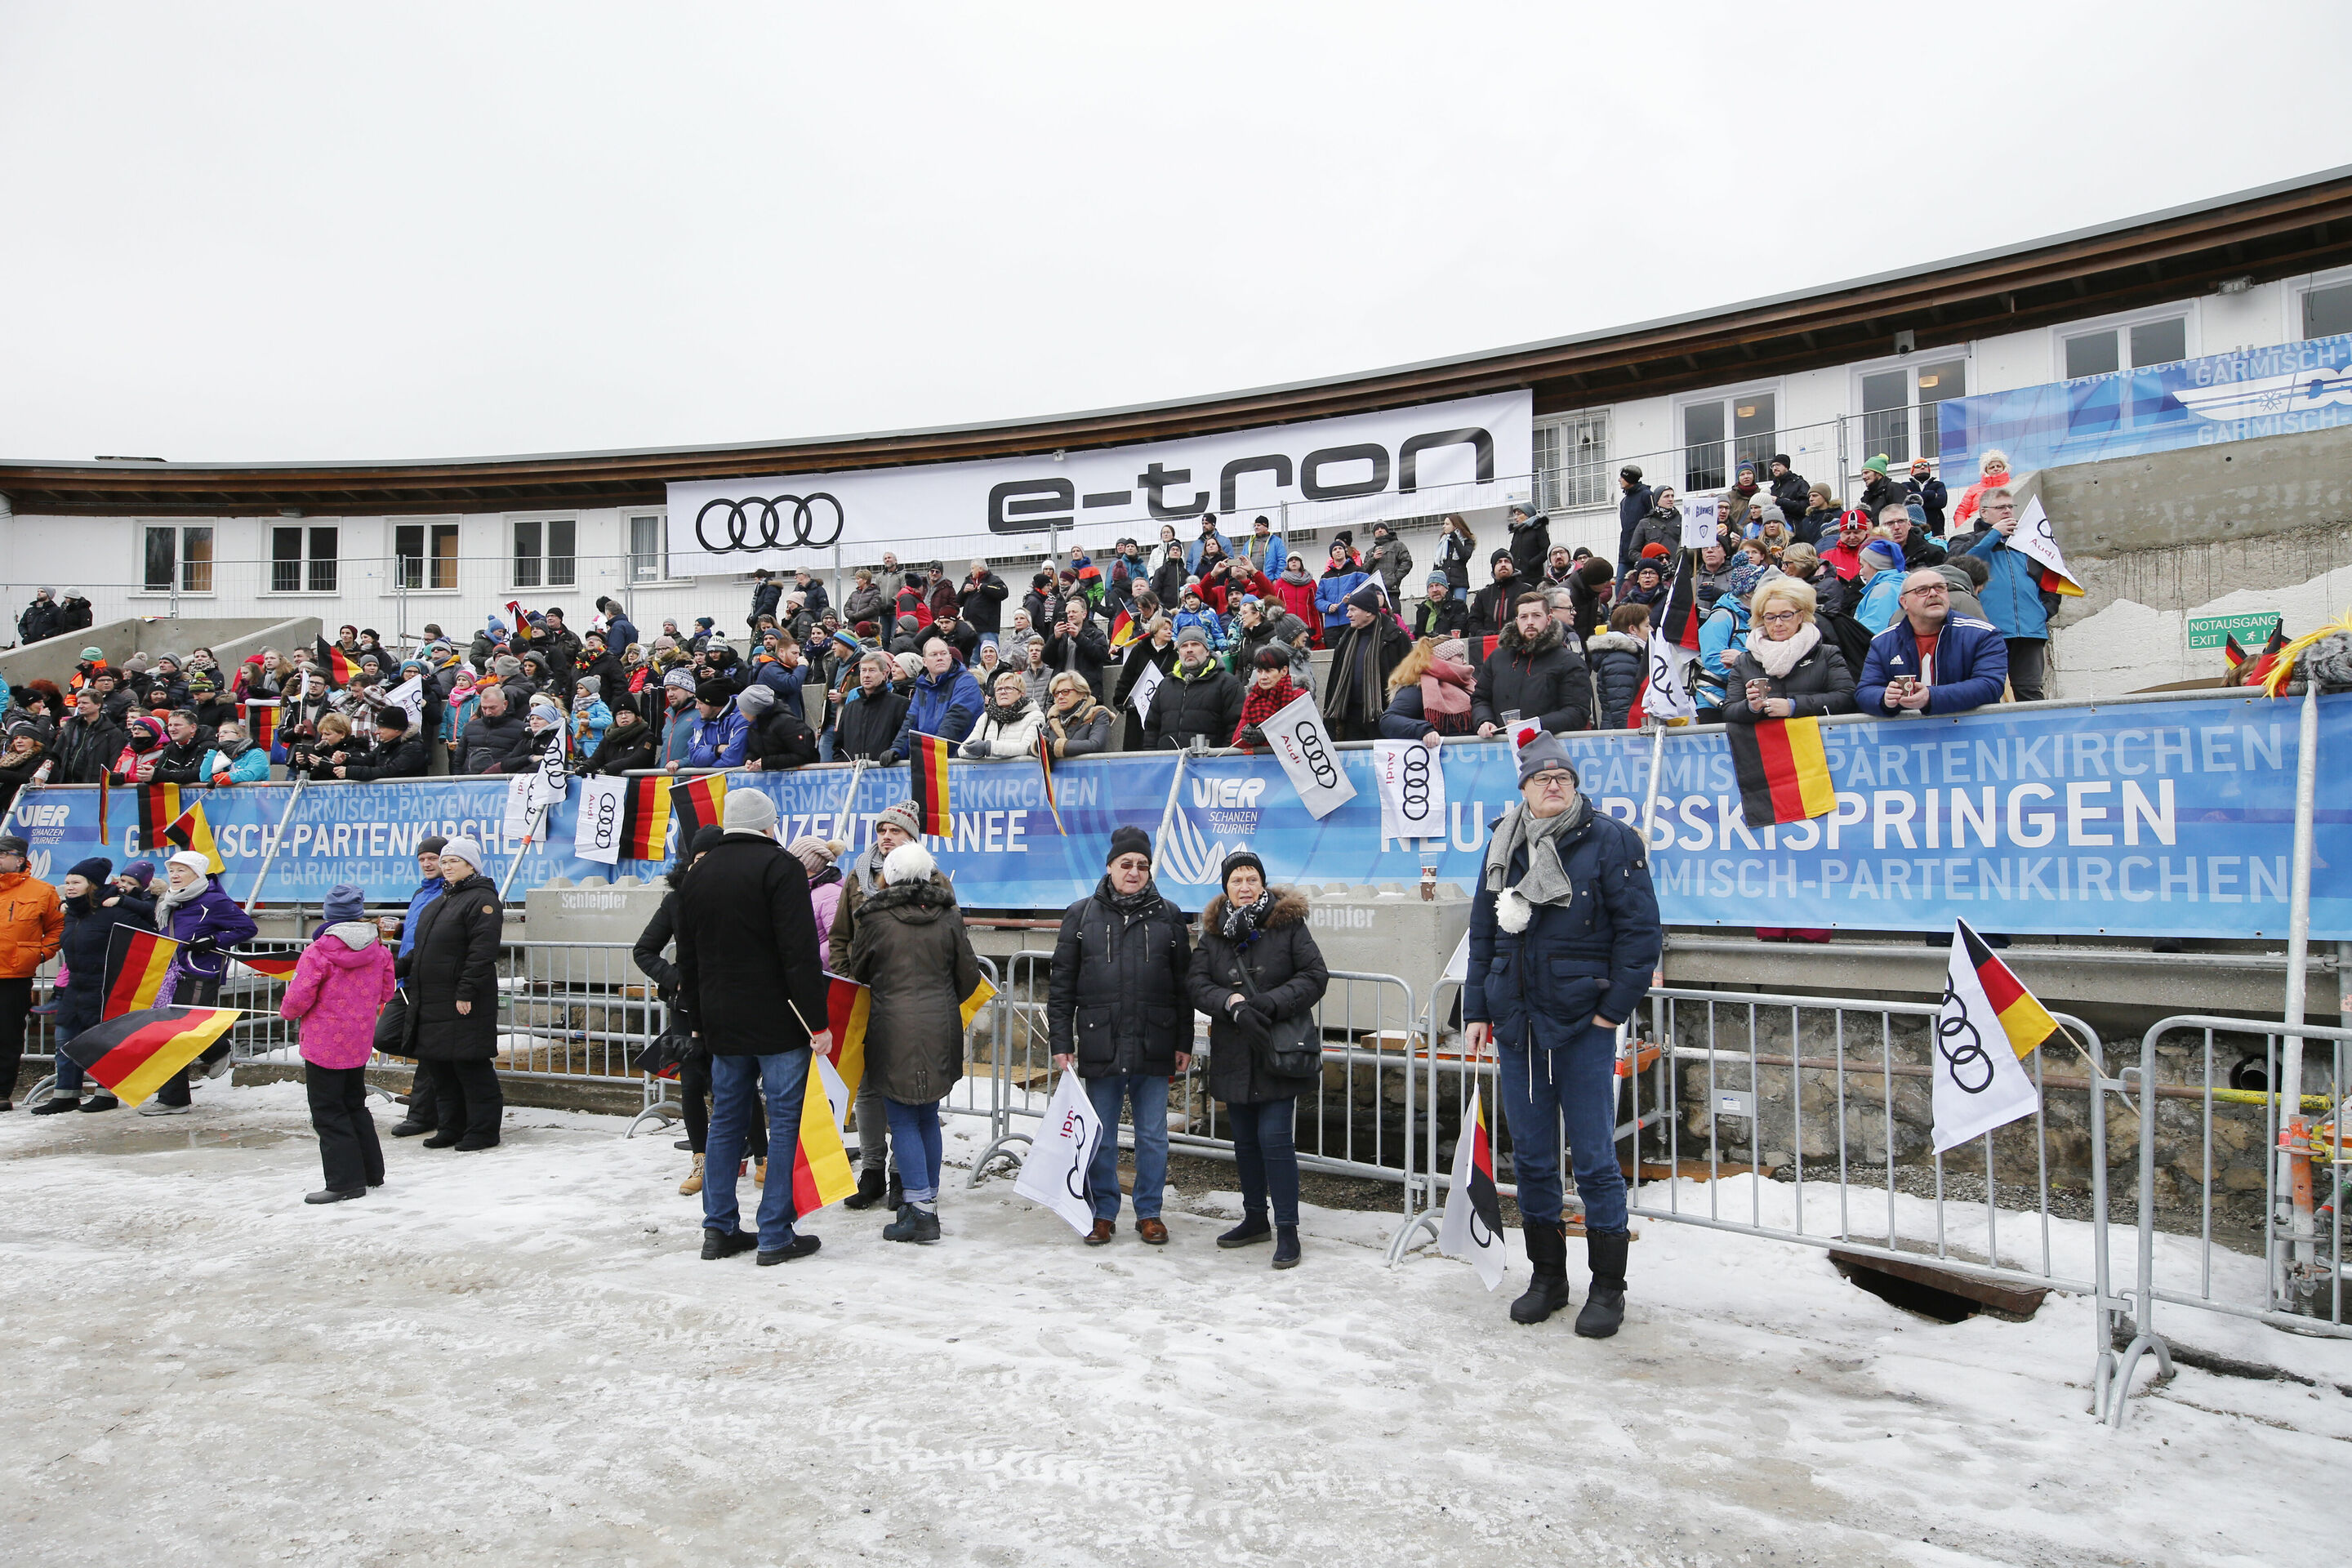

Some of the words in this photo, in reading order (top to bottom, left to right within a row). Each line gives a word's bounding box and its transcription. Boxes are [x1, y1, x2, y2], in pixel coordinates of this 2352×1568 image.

[987, 427, 1494, 532] e-tron
[2030, 538, 2056, 560] Audi
[2190, 615, 2278, 632] NOTAUSGANG
[2191, 635, 2218, 647] EXIT
[1281, 735, 1302, 764] Audi
[1386, 751, 1396, 784] Audi
[1192, 777, 1266, 808] VIER
[17, 804, 70, 827] VIER
[587, 794, 595, 820] Audi
[1209, 811, 1258, 822] SCHANZEN
[33, 836, 62, 845] TOURNEE
[1212, 823, 1256, 835] TOURNEE
[1060, 1105, 1075, 1138] udi
